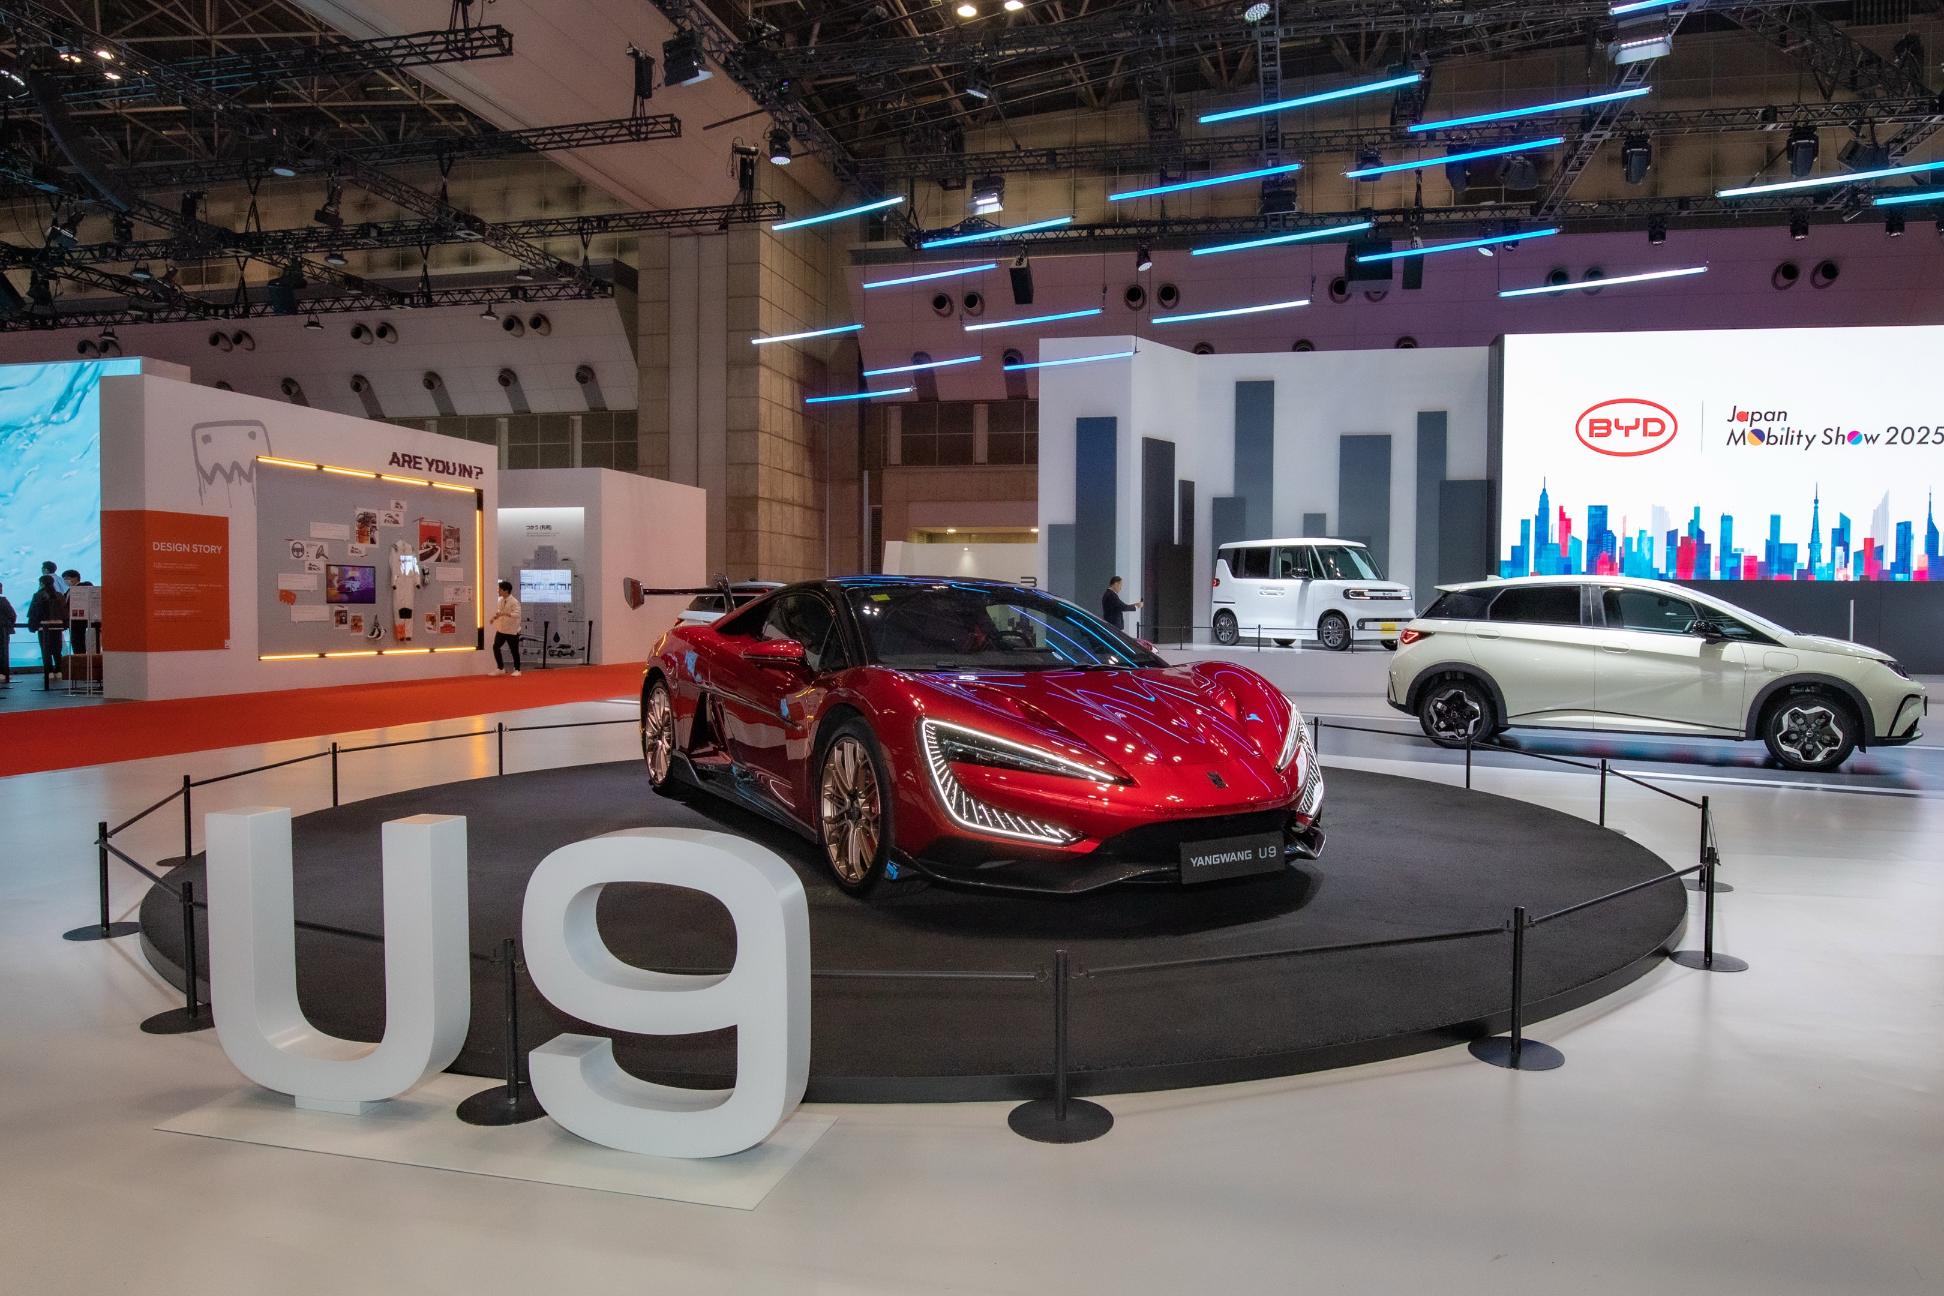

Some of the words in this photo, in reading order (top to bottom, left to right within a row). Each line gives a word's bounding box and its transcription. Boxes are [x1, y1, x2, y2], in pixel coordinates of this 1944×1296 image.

[1588, 417, 1666, 437] BYD
[1727, 405, 1788, 427] Japan
[1726, 427, 1817, 451] Mobility
[1821, 426, 1881, 446] Show
[1885, 426, 1944, 446] 2025
[388, 451, 423, 471] ARE
[424, 457, 457, 476] YOU
[458, 463, 484, 480] IN?
[152, 542, 190, 552] DESIGN
[191, 544, 222, 554] STORY
[1190, 850, 1253, 867] YANGWANG
[1258, 846, 1277, 859] U9
[205, 806, 812, 1160] U9
